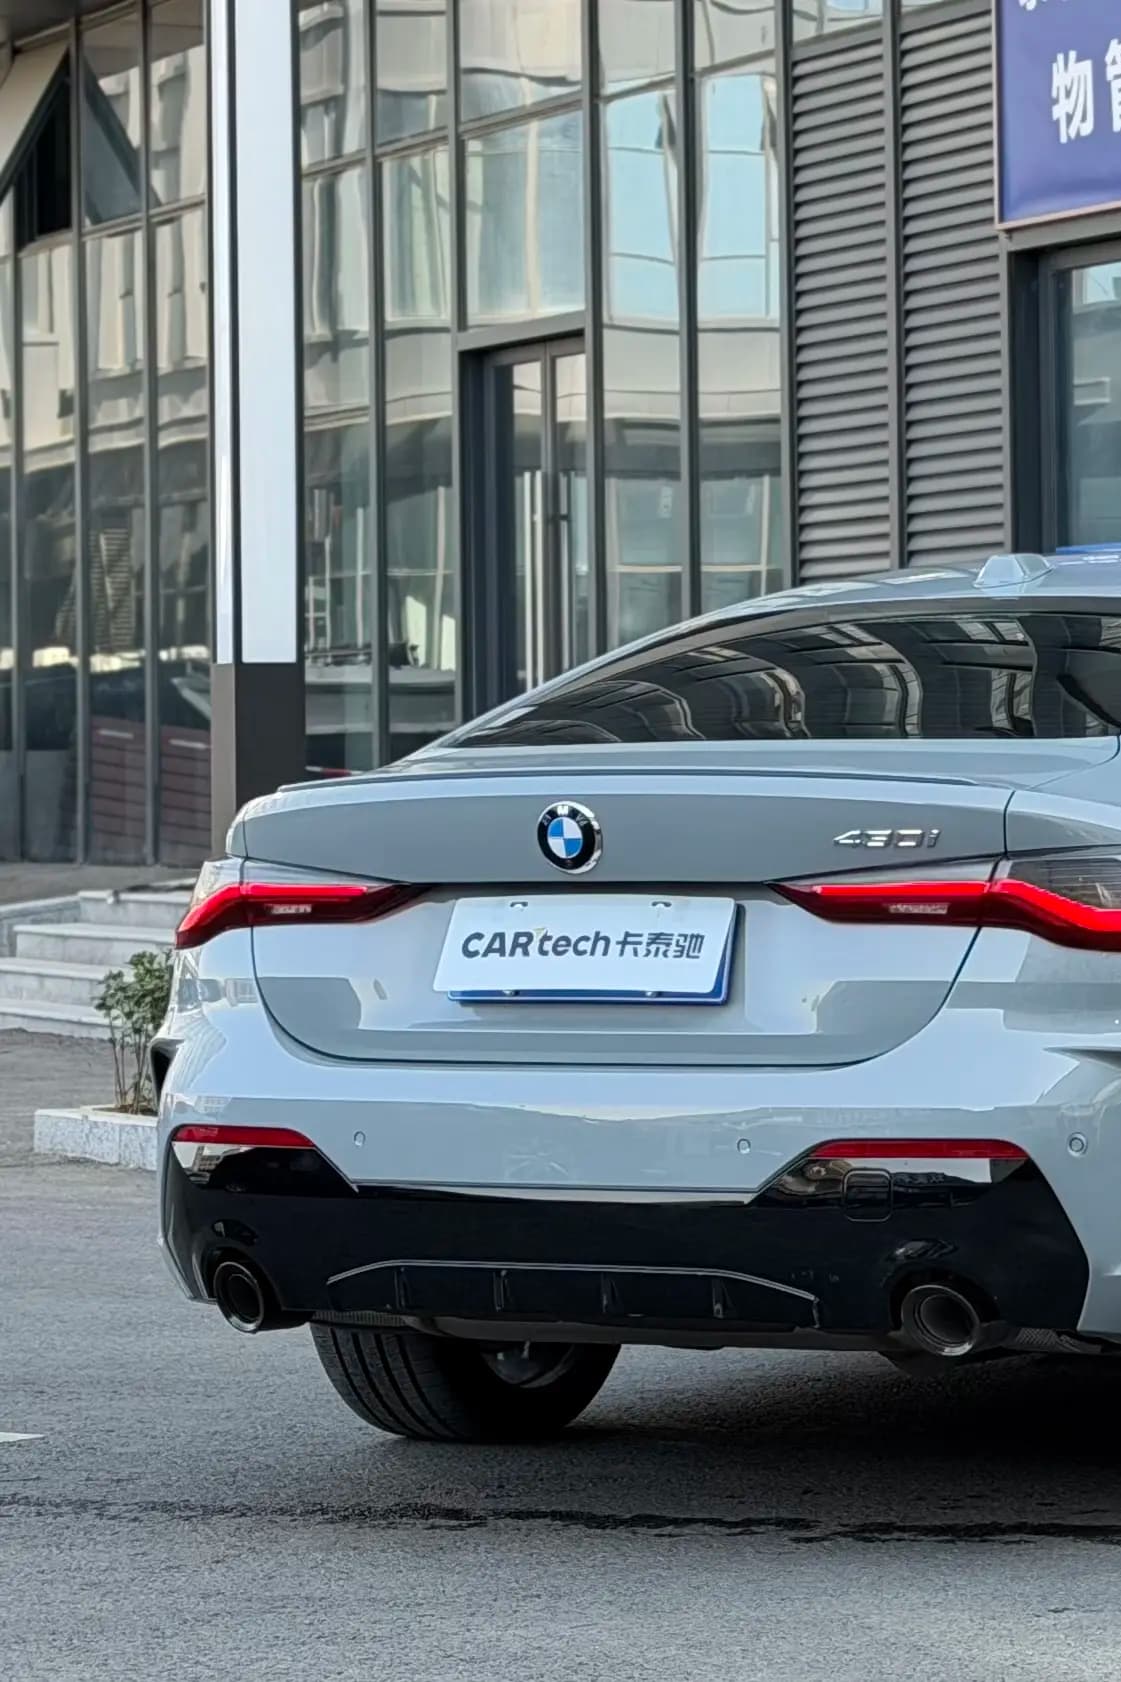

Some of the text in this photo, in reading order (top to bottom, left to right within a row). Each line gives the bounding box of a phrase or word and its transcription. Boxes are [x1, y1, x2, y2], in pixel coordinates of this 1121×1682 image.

[833, 828, 941, 850] 430i
[461, 929, 705, 960] CARtech 卡泰驰
